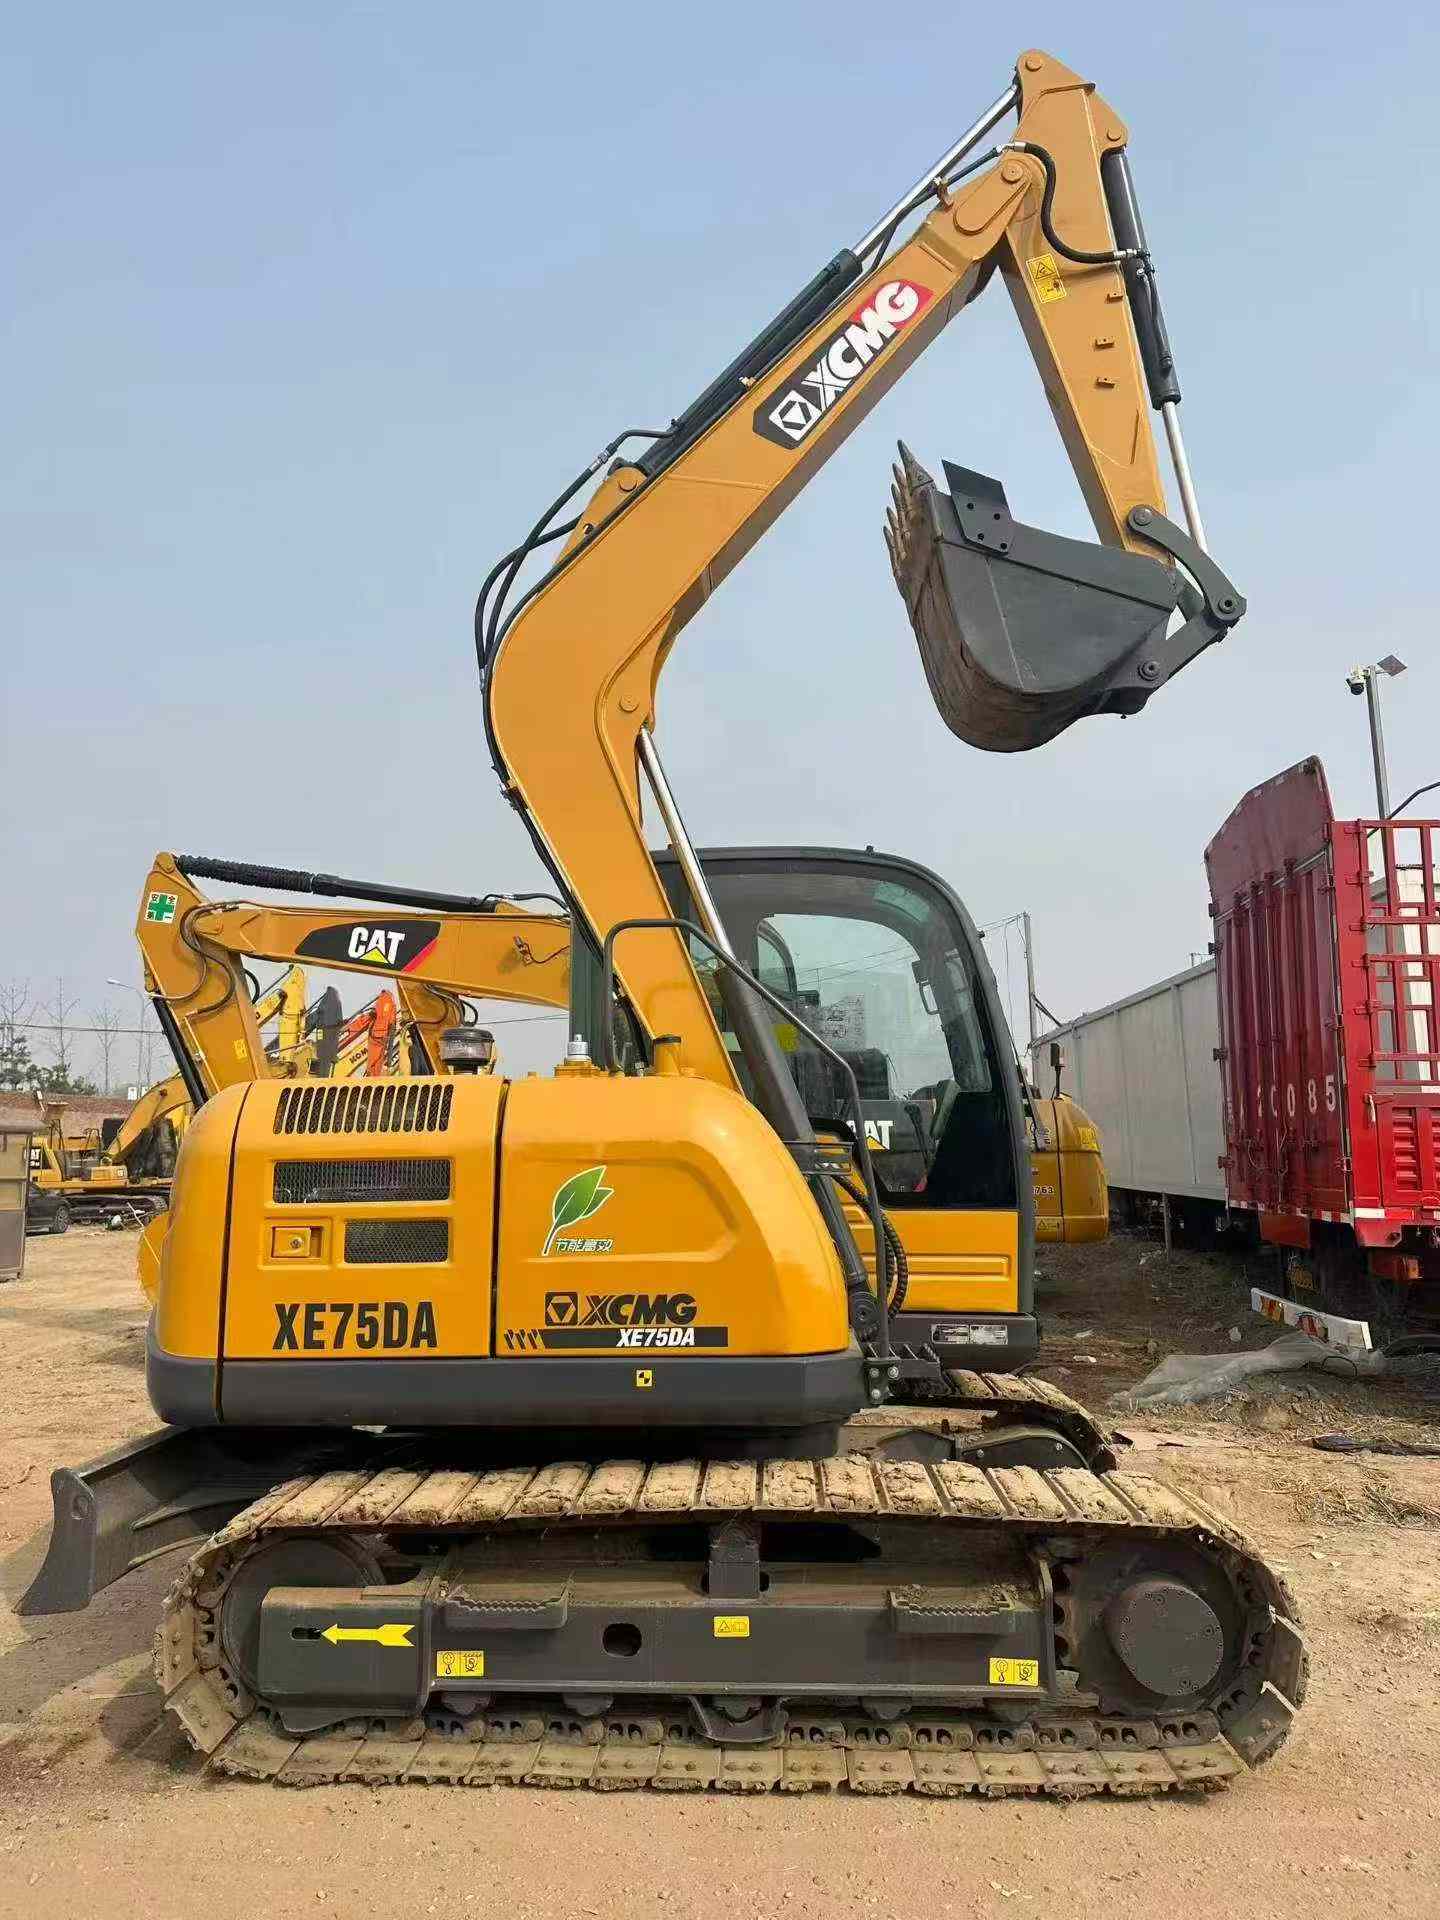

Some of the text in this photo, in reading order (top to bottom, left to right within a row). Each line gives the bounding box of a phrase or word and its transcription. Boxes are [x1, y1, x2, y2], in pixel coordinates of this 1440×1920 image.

[800, 281, 919, 412] XCMG
[347, 926, 406, 965] CAT
[272, 1301, 438, 1350] XE75DA
[579, 1293, 698, 1326] XCMG
[615, 1327, 696, 1348] XE75DA
